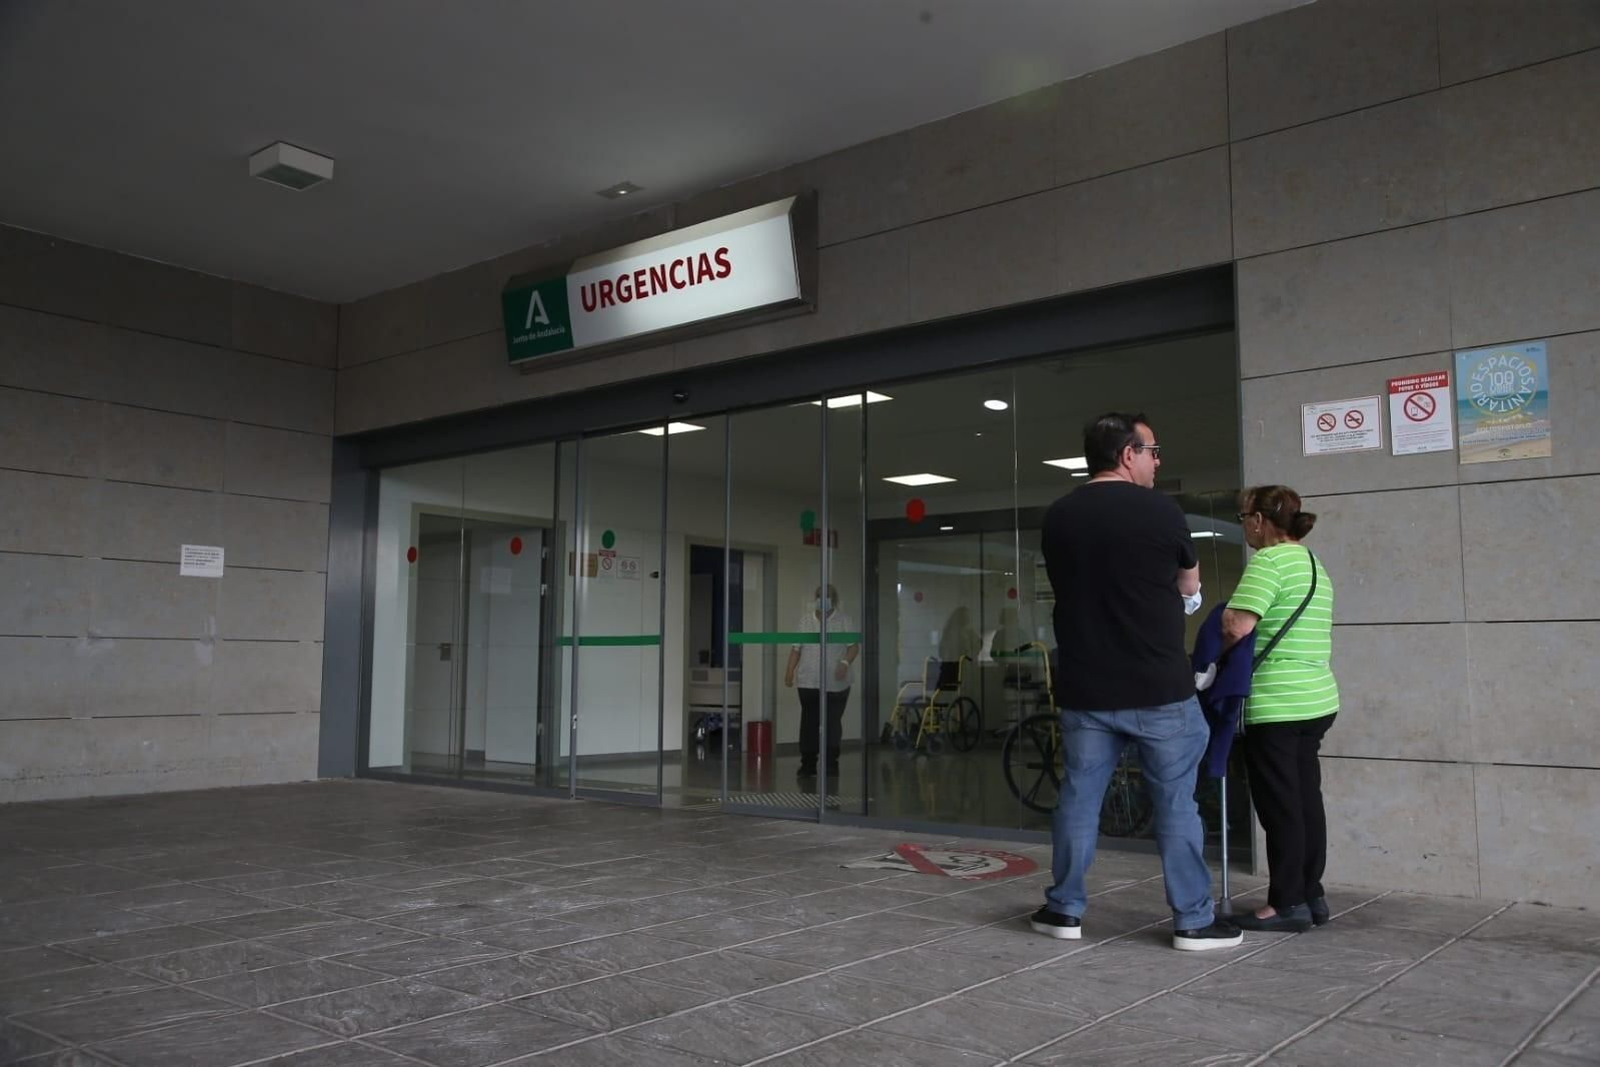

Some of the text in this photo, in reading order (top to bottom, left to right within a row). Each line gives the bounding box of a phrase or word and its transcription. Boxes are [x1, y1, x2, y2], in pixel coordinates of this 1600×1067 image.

[580, 247, 732, 312] URGENCIAS
[512, 335, 528, 344] Junta
[528, 332, 536, 340] de
[1391, 374, 1446, 387] PROHIBIDO REALIZAR
[1488, 371, 1514, 385] 100
